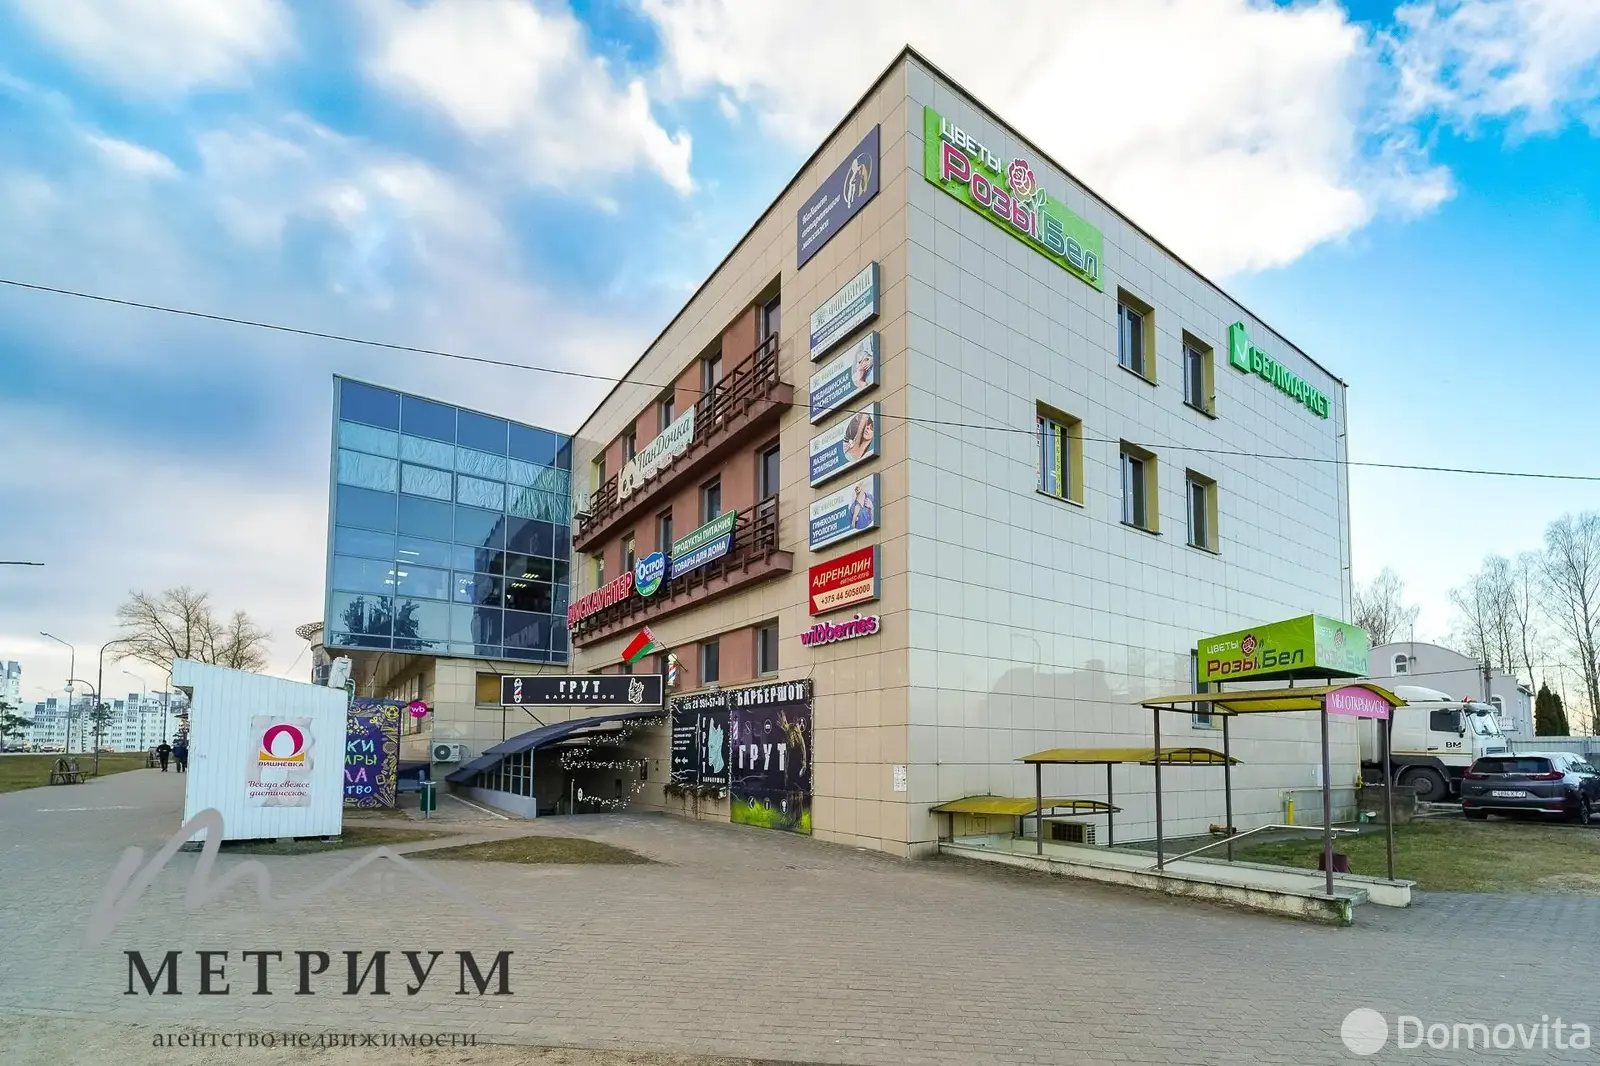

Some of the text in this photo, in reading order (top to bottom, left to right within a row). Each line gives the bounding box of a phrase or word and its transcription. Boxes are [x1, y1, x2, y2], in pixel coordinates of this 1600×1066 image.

[939, 116, 1002, 174] ЦВЕТЫ
[1249, 345, 1330, 419] БЕЛМАРКЕТ
[812, 447, 838, 467] ЛАЗЕРНАЯ
[812, 456, 839, 476] ЭПИЛЯЦИЯ
[812, 509, 847, 530] ГИНЕКОЛОГИЯ
[674, 517, 731, 555] ПРОДУКТЫ ПИТАНИЯ
[812, 523, 838, 540] УРОЛОГИЯ
[674, 541, 726, 573] ТОВАРЫ ДЛЯ ДОМА
[812, 557, 871, 588] АДРЕНАЛИН
[566, 571, 633, 630] ДИСКАУНТЕР
[820, 594, 835, 606] +375
[836, 592, 844, 602] 44
[800, 613, 880, 646] wildberries
[1207, 640, 1240, 655] ЦВЕТЫ
[559, 680, 600, 693] ГРУТ
[737, 683, 804, 706] БАРБЕРШОП
[1331, 693, 1344, 709] МЫ
[738, 743, 787, 771] ГРУТ
[248, 780, 310, 790] Всегда свежее
[249, 791, 307, 799] диетическое
